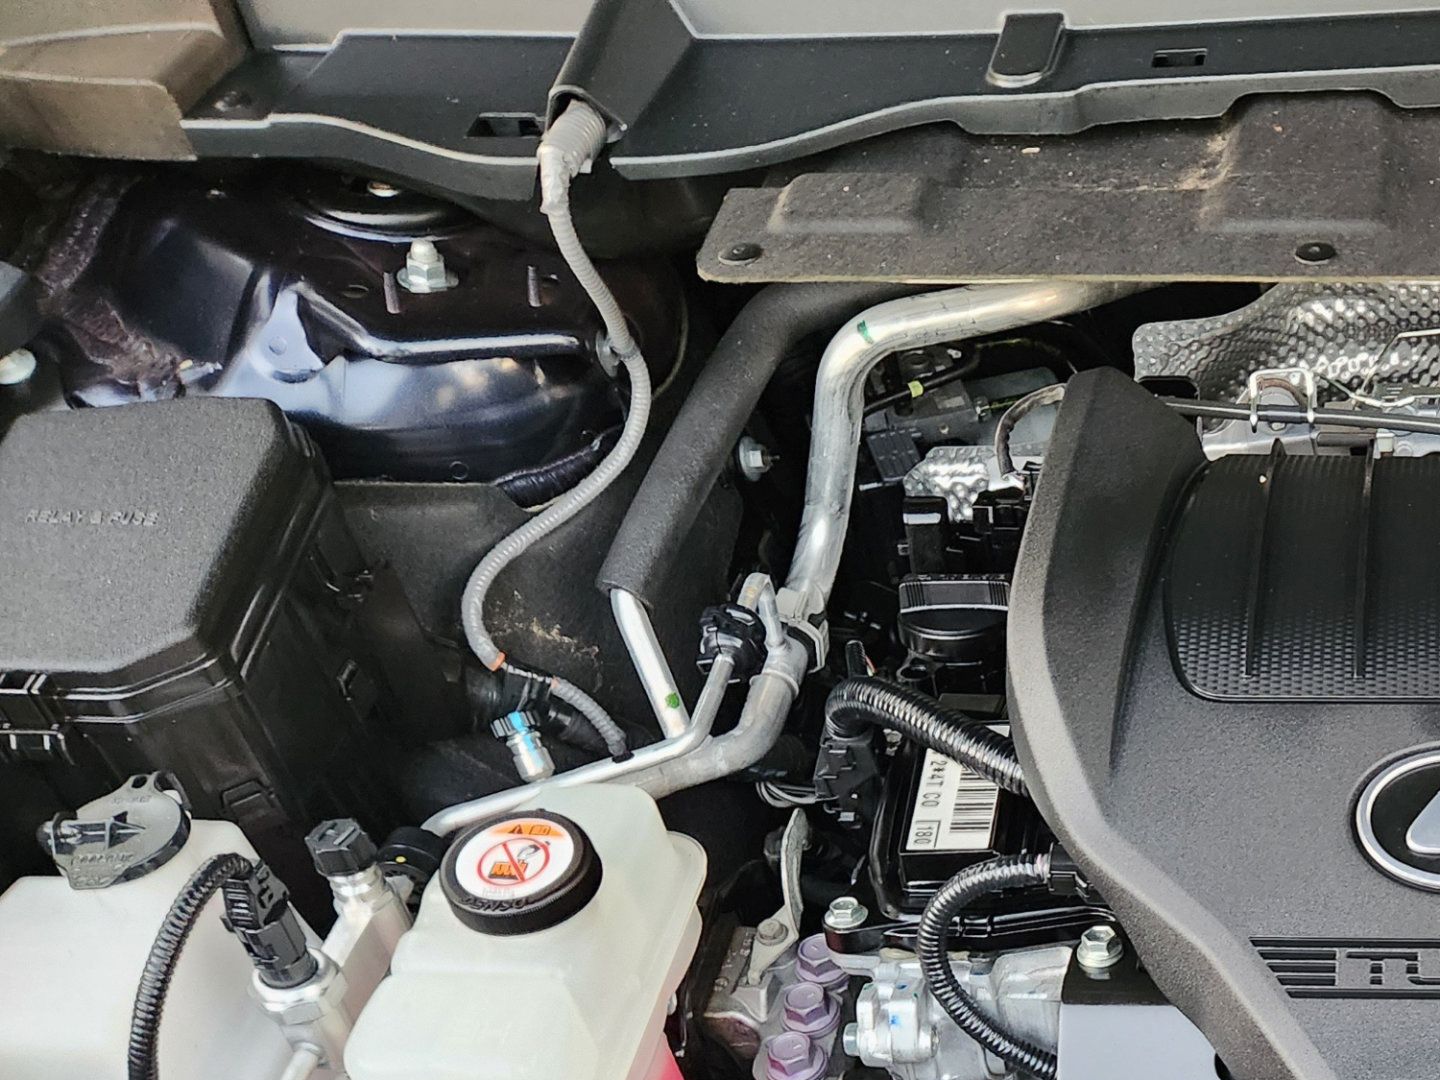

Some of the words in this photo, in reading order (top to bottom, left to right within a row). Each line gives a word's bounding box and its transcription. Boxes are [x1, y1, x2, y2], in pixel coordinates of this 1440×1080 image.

[26, 508, 86, 523] RELAY
[109, 510, 160, 527] FUSE
[913, 826, 934, 845] 180
